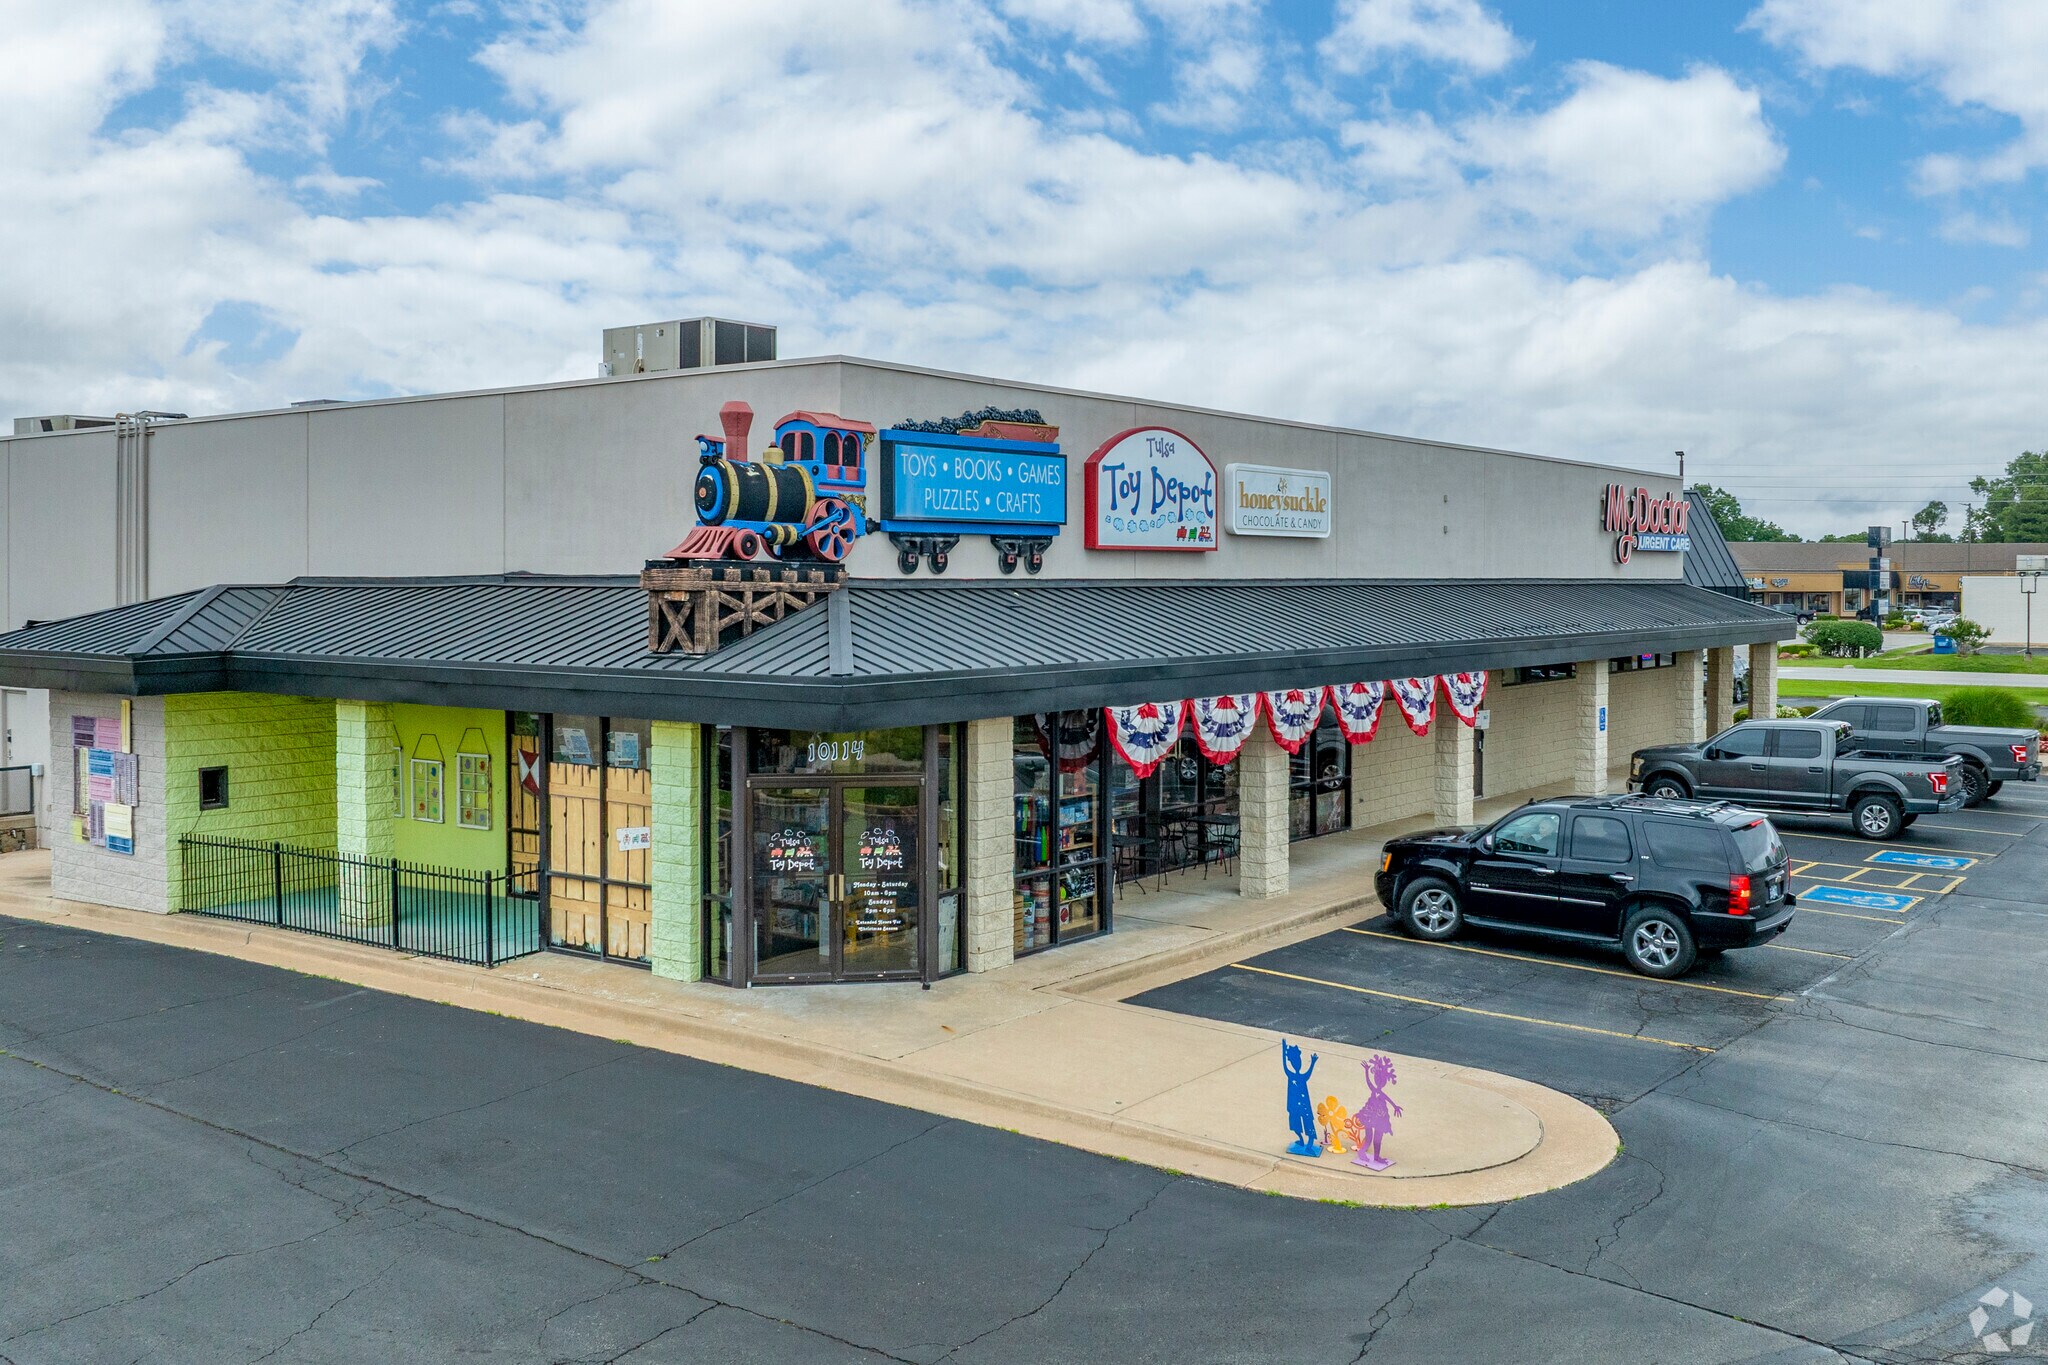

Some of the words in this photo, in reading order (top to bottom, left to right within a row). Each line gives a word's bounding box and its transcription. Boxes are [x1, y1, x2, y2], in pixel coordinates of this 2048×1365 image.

[1146, 437, 1175, 458] Tulsa
[901, 453, 937, 478] TOYS
[954, 457, 1002, 482] BOOKS
[1018, 462, 1061, 486] GAMES
[924, 487, 979, 512] PUZZLES
[996, 491, 1041, 514] CRAFTS
[1102, 462, 1141, 515] Toy
[1151, 466, 1213, 522] Depot
[1238, 481, 1327, 516] honeysuckle
[1242, 514, 1289, 528] CHOCOLATE
[1290, 516, 1296, 528] &
[1298, 517, 1322, 529] CANDY
[1604, 483, 1637, 564] My
[1636, 487, 1691, 535] Doctor
[1638, 535, 1670, 550] URGENT
[1670, 537, 1690, 551] CARE
[808, 740, 864, 762] 10114
[780, 837, 801, 847] Tulsa
[868, 836, 889, 845] Tulsa
[769, 858, 785, 870] Toy
[787, 858, 815, 871] Depot
[859, 857, 874, 869] Toy
[876, 857, 903, 870] Depot
